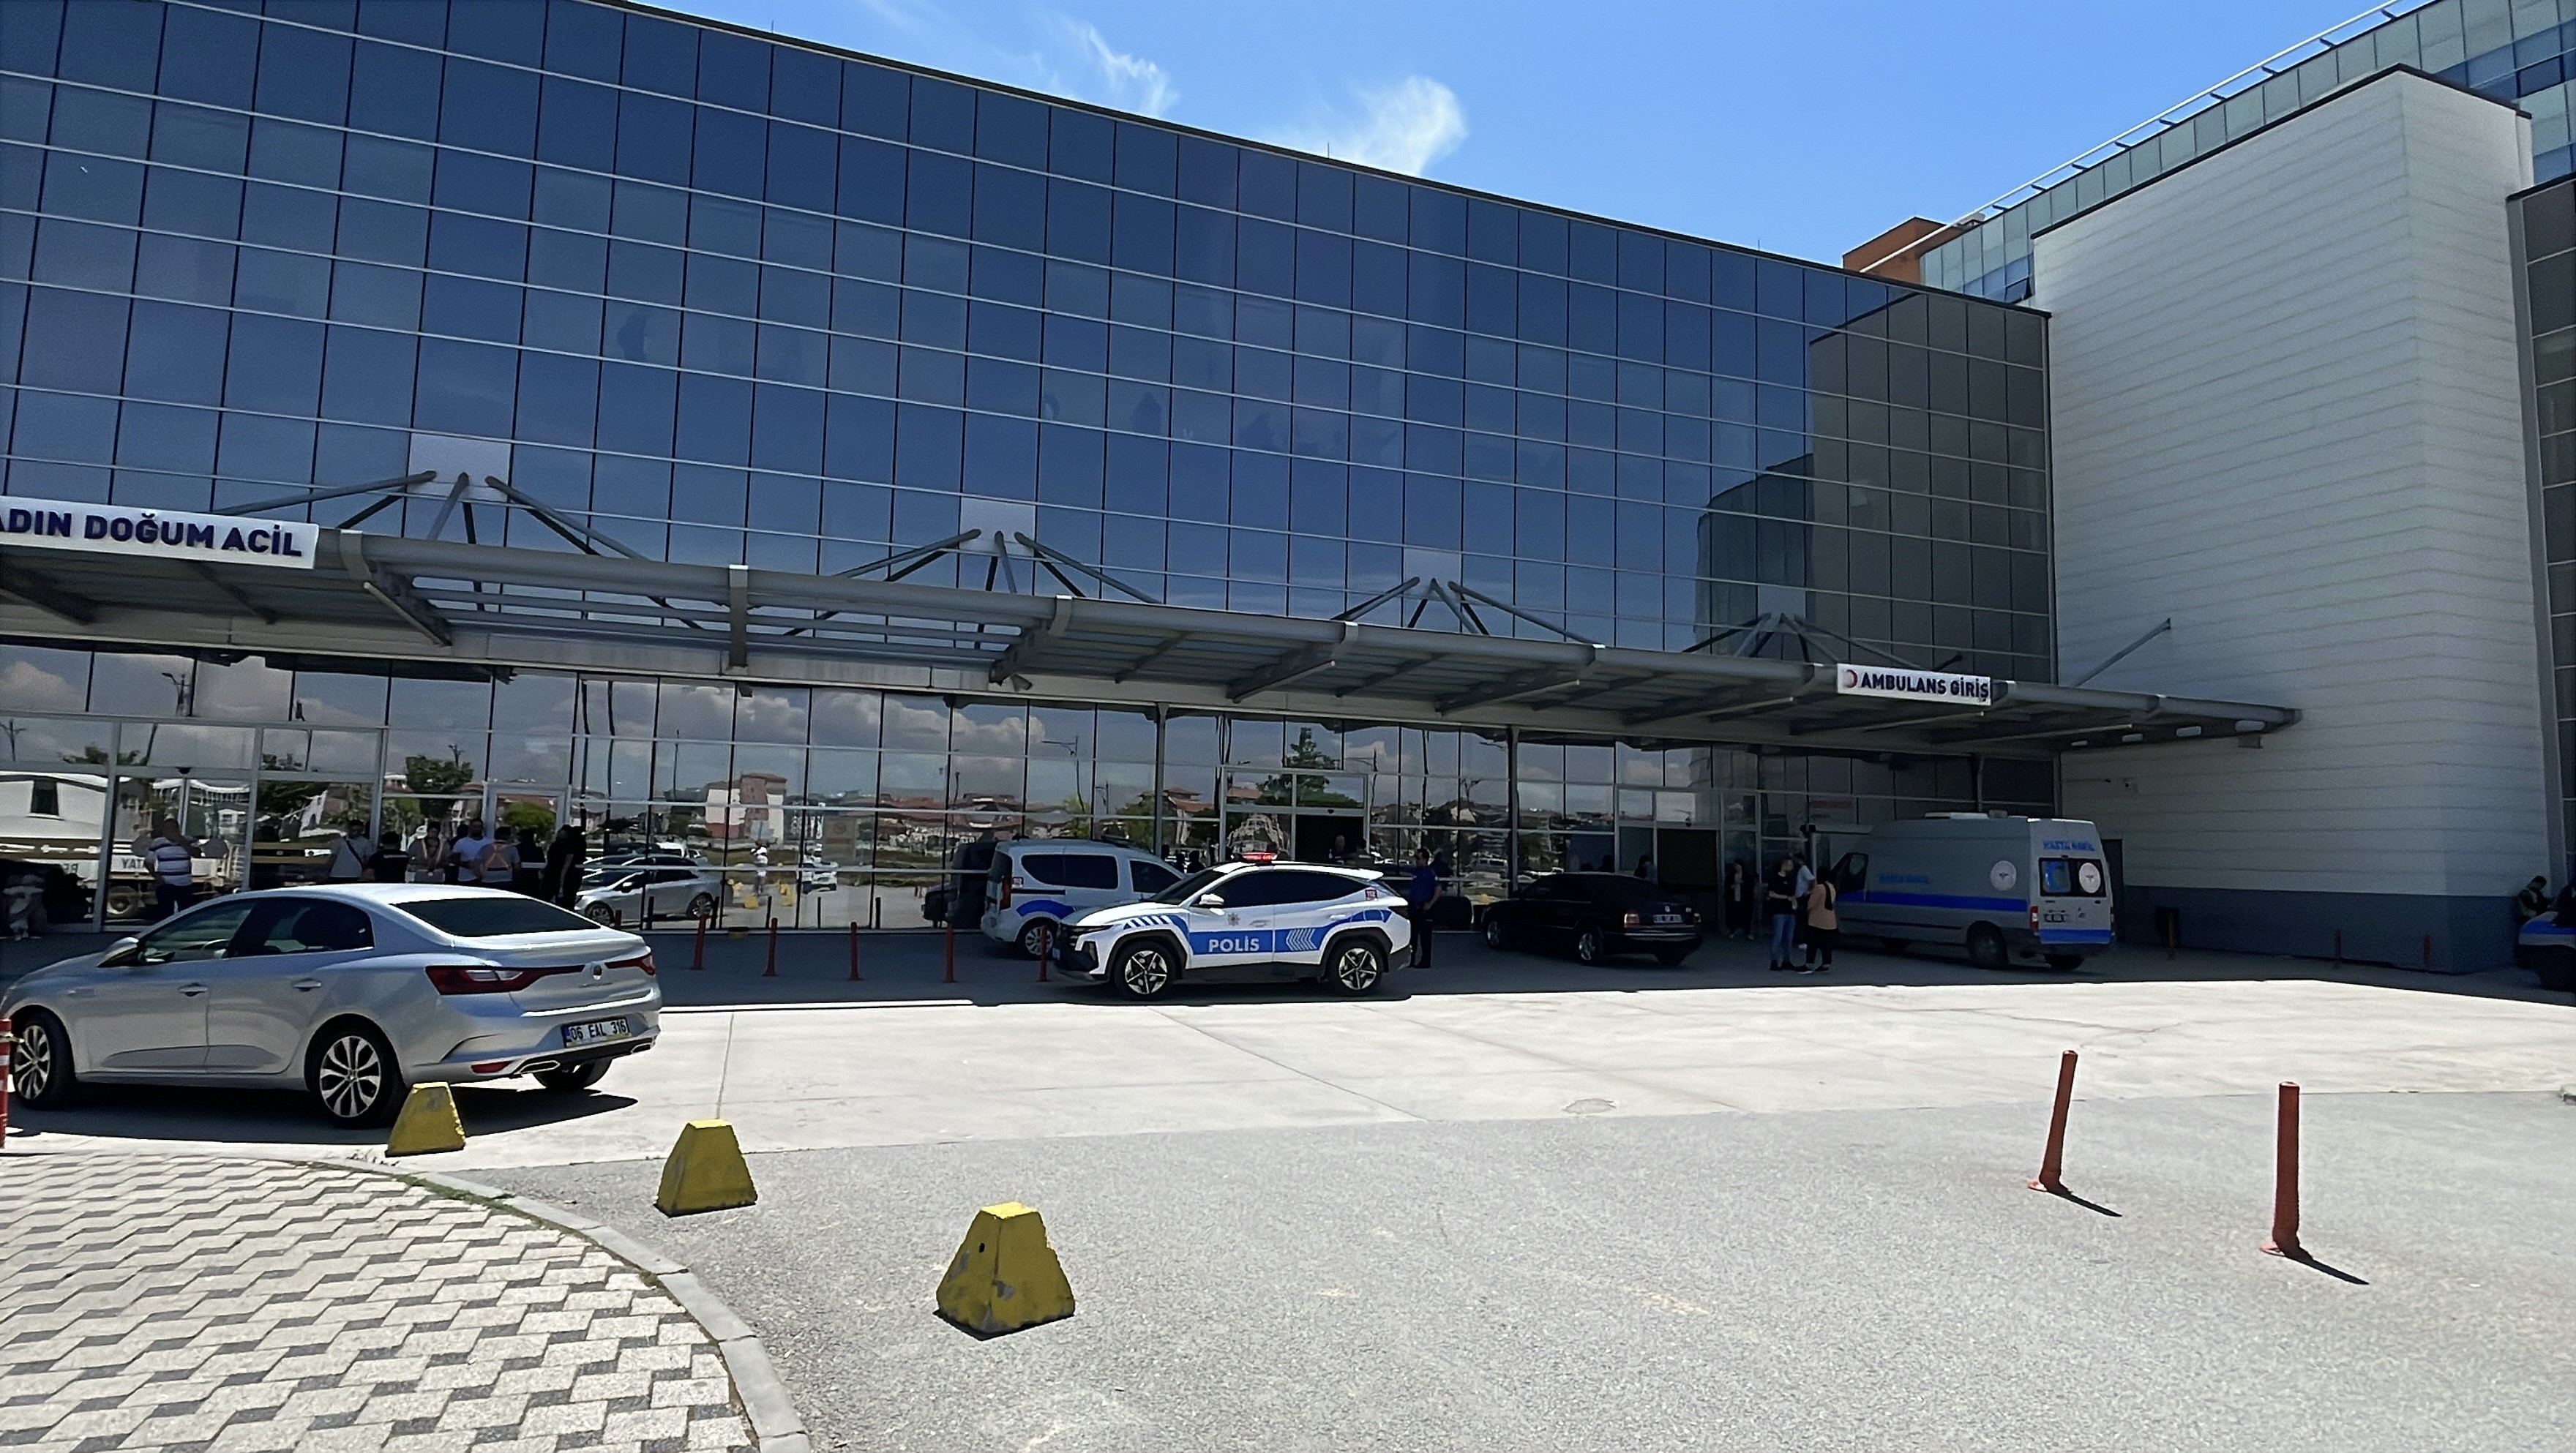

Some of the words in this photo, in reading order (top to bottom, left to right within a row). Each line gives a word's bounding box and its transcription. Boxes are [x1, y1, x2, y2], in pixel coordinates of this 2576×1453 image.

[84, 512, 214, 549] DOĞUM
[221, 524, 302, 557] ACİL
[1861, 672, 1947, 695] AMBULANS
[1208, 935, 1259, 953] POLİS
[570, 1026, 584, 1040] 06
[588, 1024, 607, 1038] EAL
